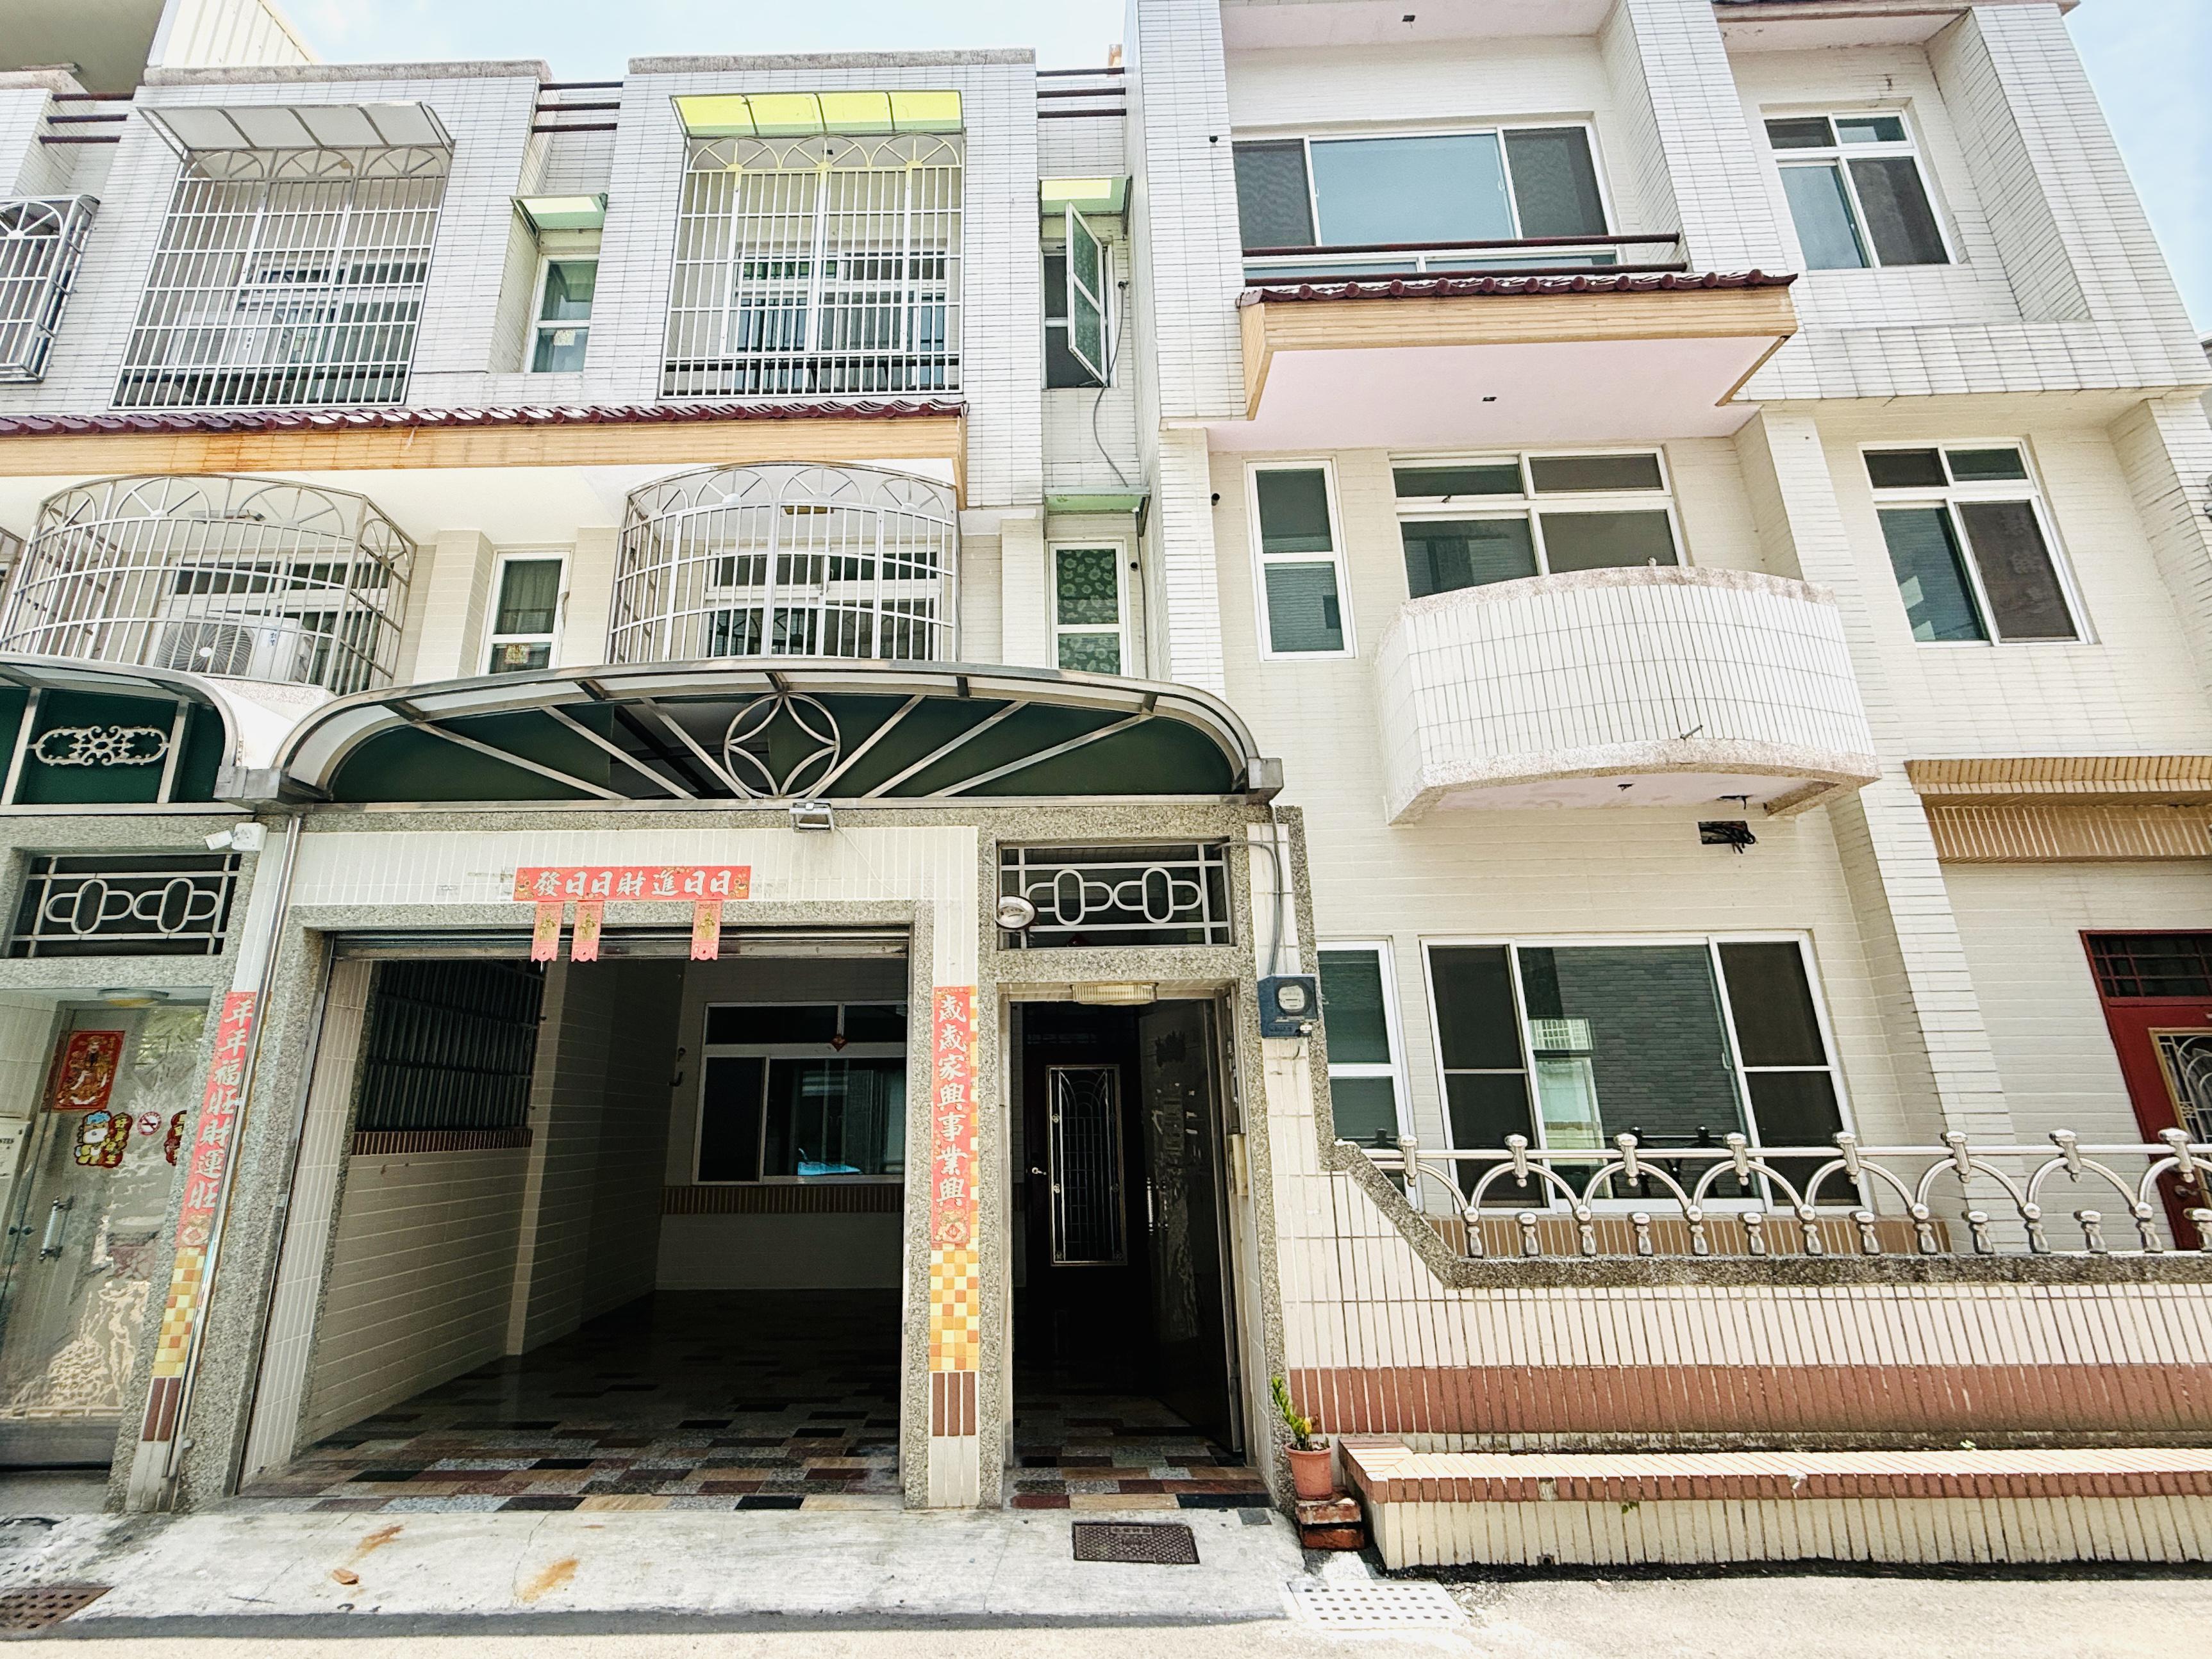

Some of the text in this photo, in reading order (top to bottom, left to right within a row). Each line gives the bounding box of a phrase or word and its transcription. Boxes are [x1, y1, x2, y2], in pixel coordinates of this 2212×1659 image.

[187, 999, 253, 1210] 年年福旺財運旺
[936, 994, 968, 1207] 歲歲家興事業興
